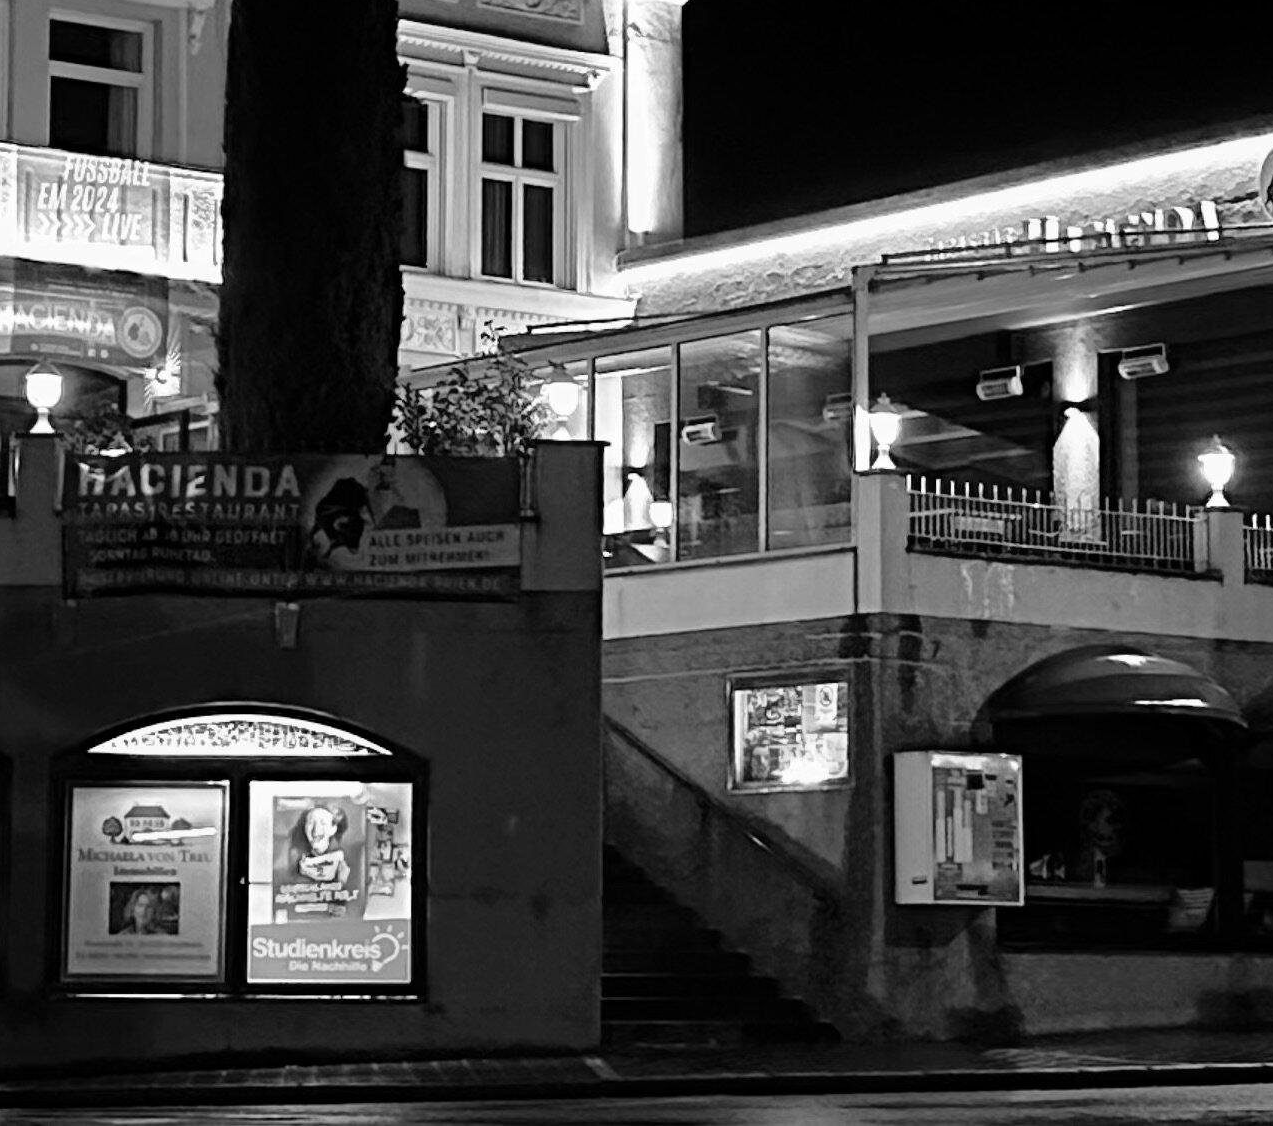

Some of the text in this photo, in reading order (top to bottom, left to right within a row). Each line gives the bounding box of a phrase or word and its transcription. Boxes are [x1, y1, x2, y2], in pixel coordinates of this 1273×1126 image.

[63, 156, 151, 187] FUSSBALL
[37, 182, 120, 214] EM 2024
[100, 212, 143, 244] LIVE
[77, 461, 302, 498] HACIENDA
[252, 937, 382, 959] Studienkreis
